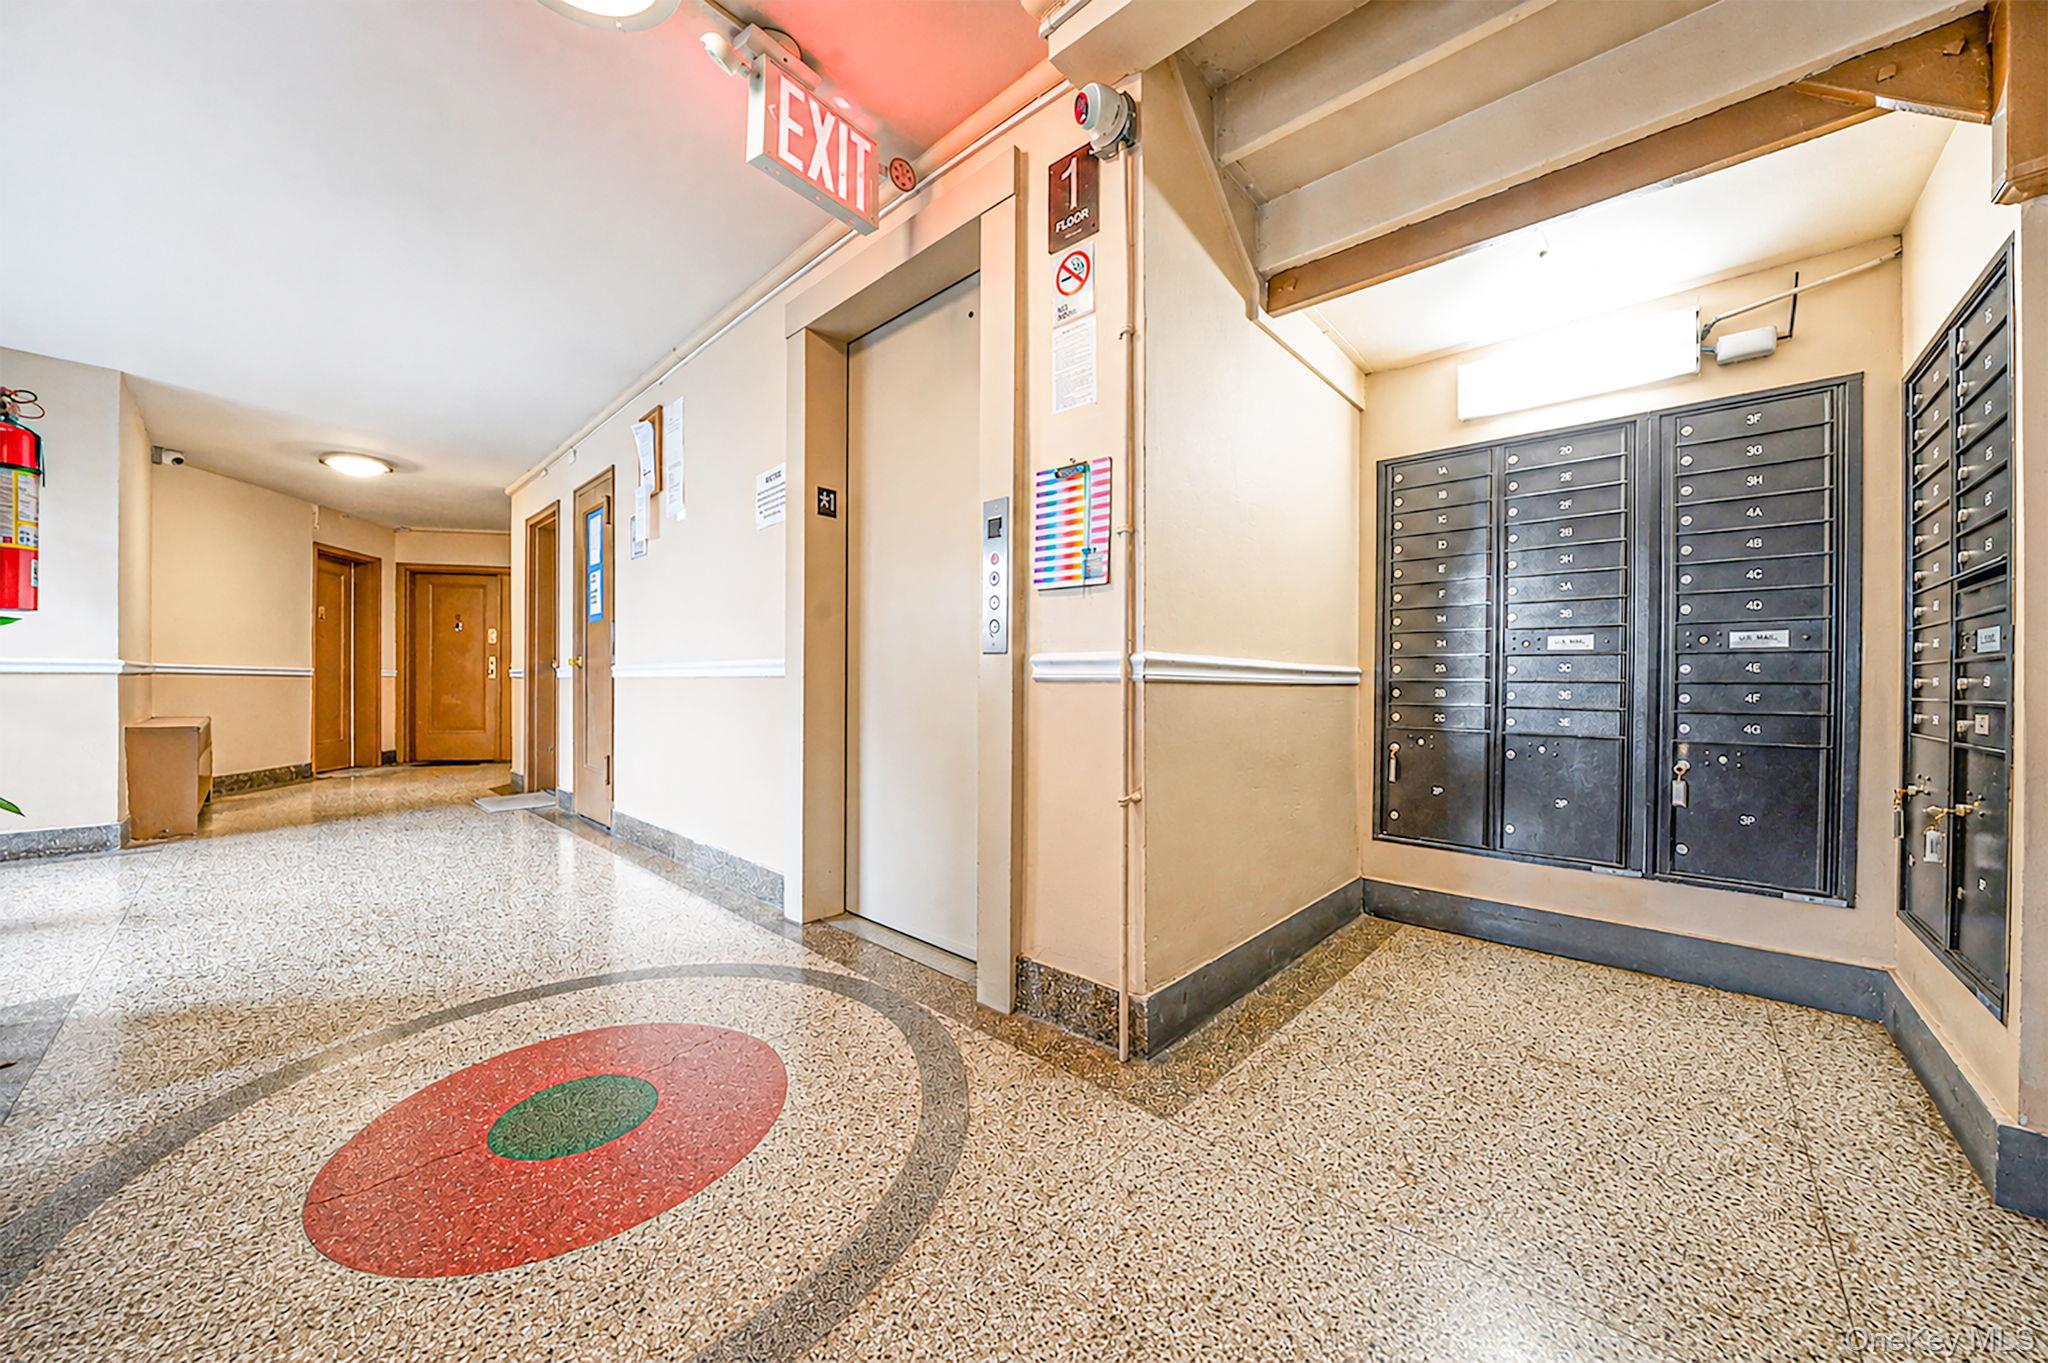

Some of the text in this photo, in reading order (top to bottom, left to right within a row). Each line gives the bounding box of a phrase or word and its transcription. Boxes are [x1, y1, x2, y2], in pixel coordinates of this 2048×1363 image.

[778, 75, 872, 212] EXIT
[1061, 156, 1078, 210] 1
[1055, 207, 1090, 233] FLOOR
[1746, 413, 1762, 425] 3F
[1746, 506, 1763, 517] 4A
[1746, 537, 1762, 548] 4B
[1746, 568, 1763, 579] 4C
[1560, 582, 1573, 591] 3A
[1746, 600, 1763, 611] 4D
[1745, 662, 1761, 673] 4E
[1744, 693, 1761, 703] 4F
[1743, 724, 1762, 734] 4G
[1739, 815, 1756, 825] 3P
